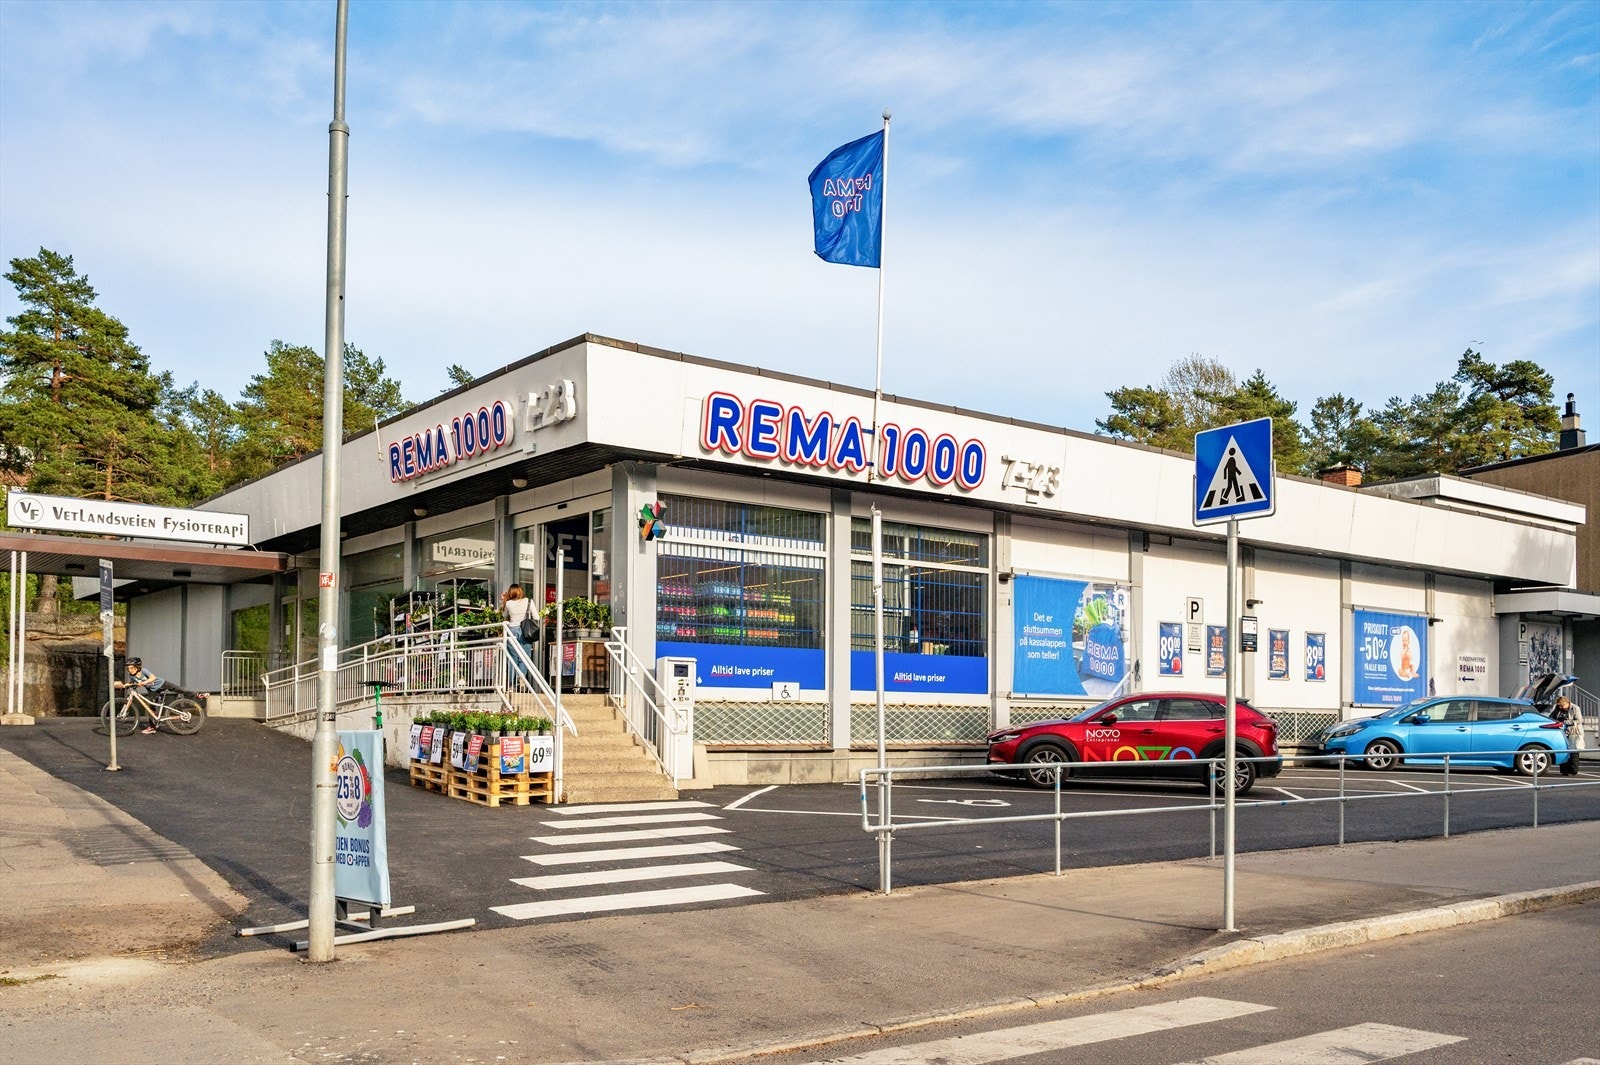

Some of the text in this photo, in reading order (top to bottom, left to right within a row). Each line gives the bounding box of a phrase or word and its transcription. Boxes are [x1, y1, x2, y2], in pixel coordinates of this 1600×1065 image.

[388, 424, 450, 483] REMA
[452, 400, 507, 460] 1000
[702, 391, 869, 473] REMA
[880, 423, 986, 490] 1000
[1033, 612, 1045, 621] Det
[1190, 601, 1200, 620] P
[1023, 625, 1063, 636] sluttsummen
[1520, 624, 1526, 639] P
[1019, 637, 1067, 649] på kassalappen
[1087, 640, 1119, 660] REMA
[1160, 636, 1174, 660] 89
[1359, 636, 1388, 660] -50%
[1027, 651, 1060, 660] som teller!
[1306, 645, 1318, 667] 89
[711, 665, 774, 677] Alltid lave priser
[1089, 657, 1115, 676] 1000
[1459, 664, 1474, 672] REMA
[893, 672, 946, 683] Alltid lave priser
[1086, 729, 1121, 738] NOVO
[532, 747, 545, 763] 69
[337, 775, 350, 799] 25
[354, 775, 361, 800] 8
[350, 837, 370, 854] BONUS
